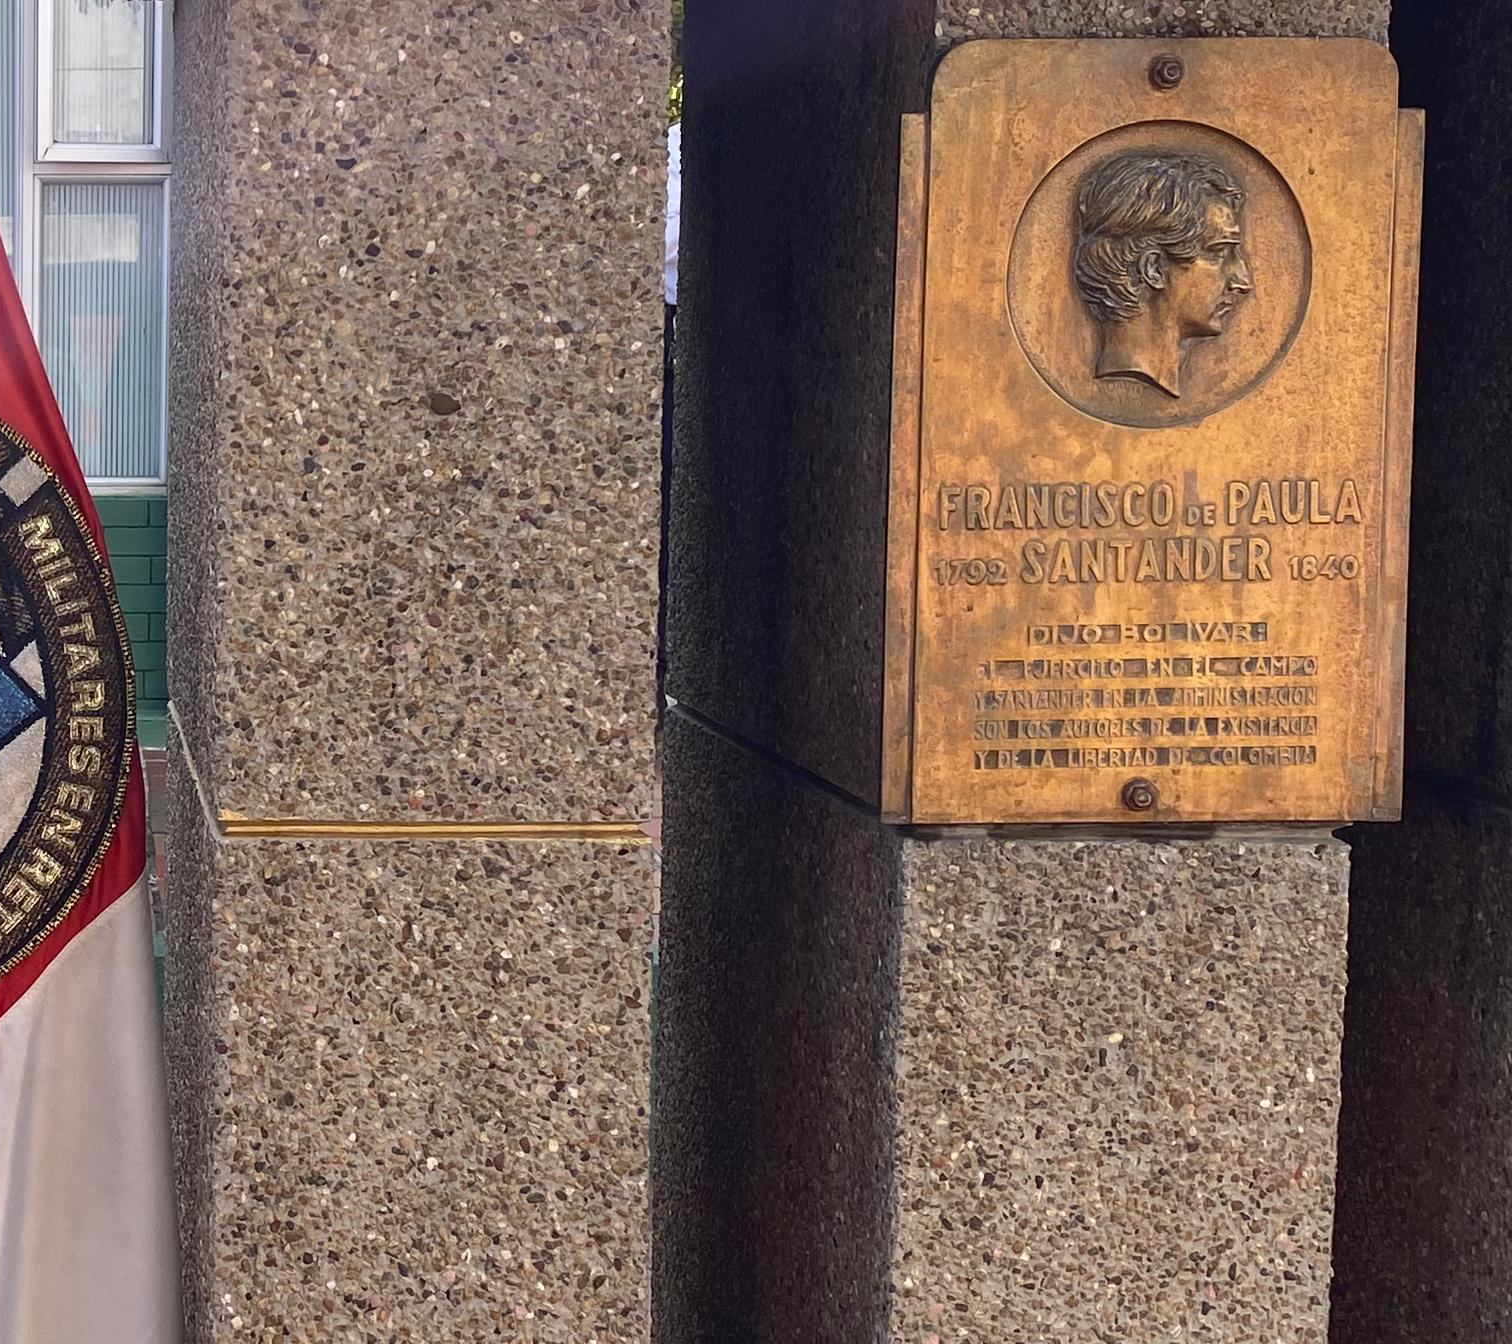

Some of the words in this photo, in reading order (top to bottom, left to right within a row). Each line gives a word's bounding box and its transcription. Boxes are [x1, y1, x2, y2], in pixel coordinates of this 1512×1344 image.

[939, 481, 1176, 532] FRANCISCO
[1186, 504, 1216, 527] DE
[1227, 479, 1364, 526] PAULA
[933, 557, 1008, 586] 1792
[1020, 536, 1274, 585] SANTANDER
[1288, 554, 1360, 582] 1840
[18, 514, 106, 774] MILITARES
[1028, 625, 1103, 645] DIJO
[1147, 657, 1174, 678] EN
[1192, 657, 1217, 678] EL
[1240, 656, 1318, 677] CAMPO
[993, 688, 1095, 709] SANTANDER
[974, 719, 1009, 740] SON
[1060, 718, 1144, 739] AUTORES
[1218, 715, 1317, 736] EXISTENCIA
[974, 749, 988, 769] Y
[998, 749, 1023, 768] DE
[1031, 748, 1055, 768] LA
[1068, 748, 1158, 768] LIBERTAD
[1209, 745, 1317, 766] COLOMBIA
[40, 781, 97, 848] EN
